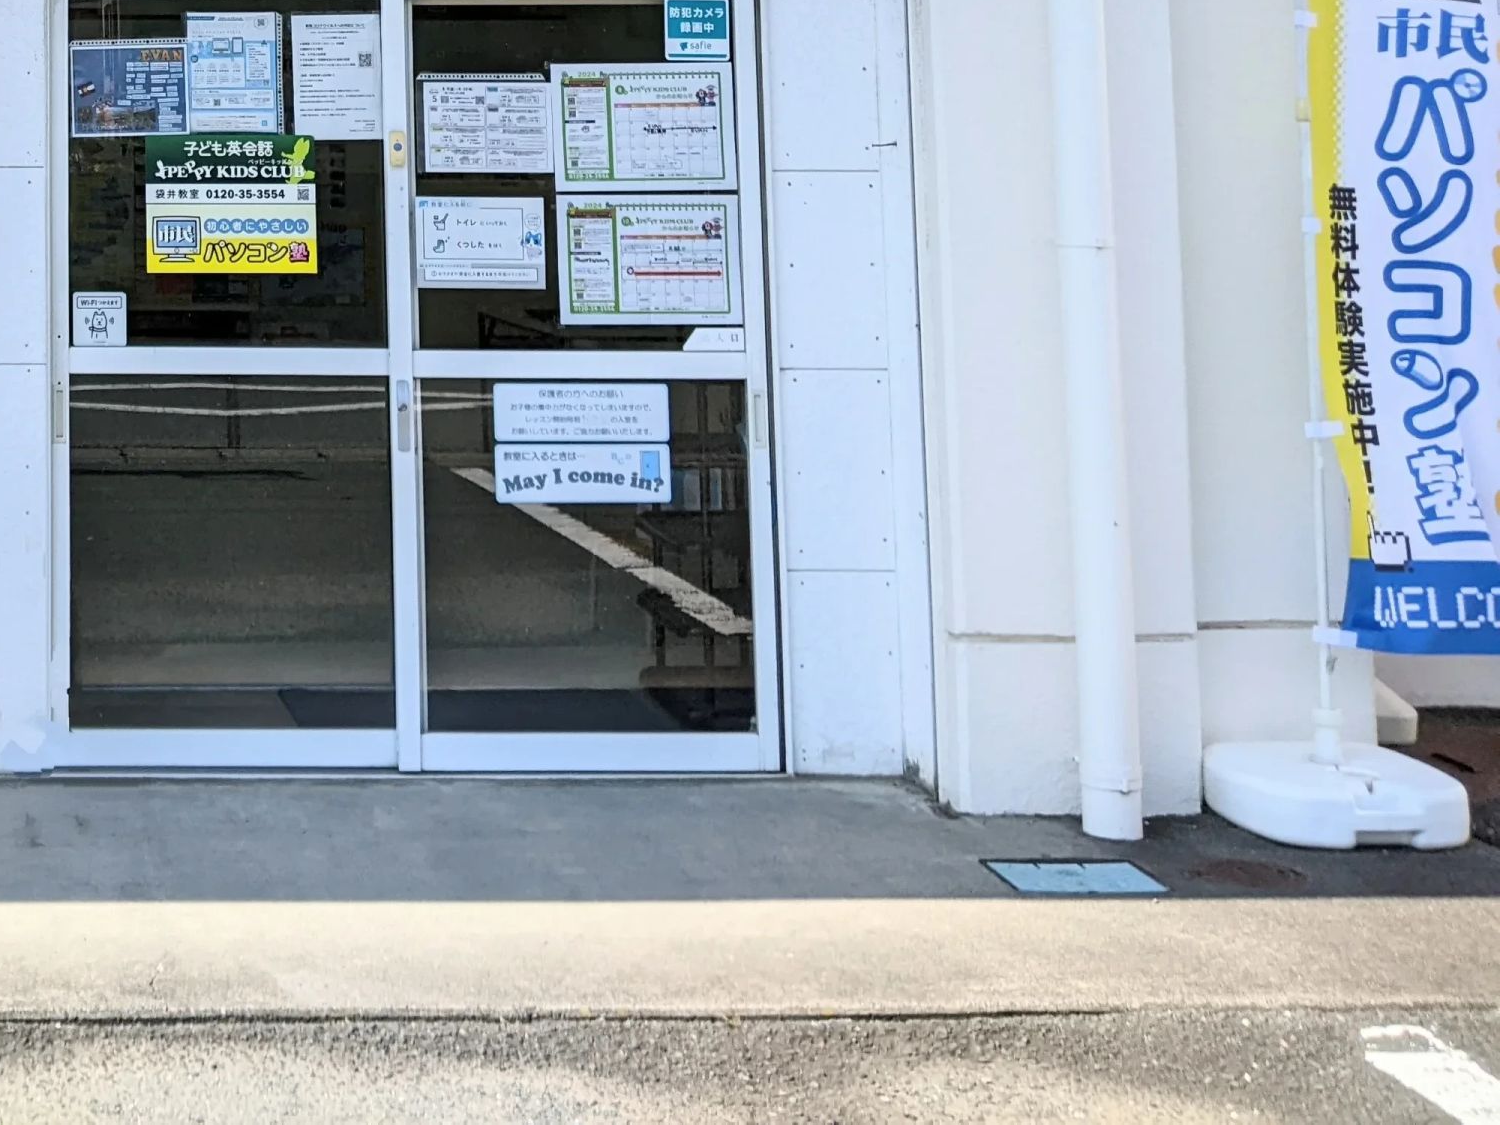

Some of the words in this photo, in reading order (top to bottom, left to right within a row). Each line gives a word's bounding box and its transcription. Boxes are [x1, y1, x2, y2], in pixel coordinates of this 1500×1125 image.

[669, 6, 724, 19] 防犯カメラ
[680, 21, 715, 34] 録画中
[1376, 8, 1490, 64] 市民
[690, 41, 712, 50] safie
[184, 140, 274, 157] 子ども英会話
[167, 160, 215, 181] PEPPY
[217, 165, 258, 178] KIDS
[260, 165, 305, 178] CLUB
[155, 188, 199, 199] 袋井教室
[206, 189, 285, 199] 0120-35-3554
[206, 220, 308, 232] 初心者にやさしい
[456, 218, 477, 226] トイレ
[158, 222, 195, 244] 市民
[203, 240, 310, 263] パソコン塾
[456, 240, 485, 249] くつした
[502, 473, 547, 495] May
[552, 468, 563, 485] I
[568, 469, 625, 485] come
[630, 472, 665, 493] in?
